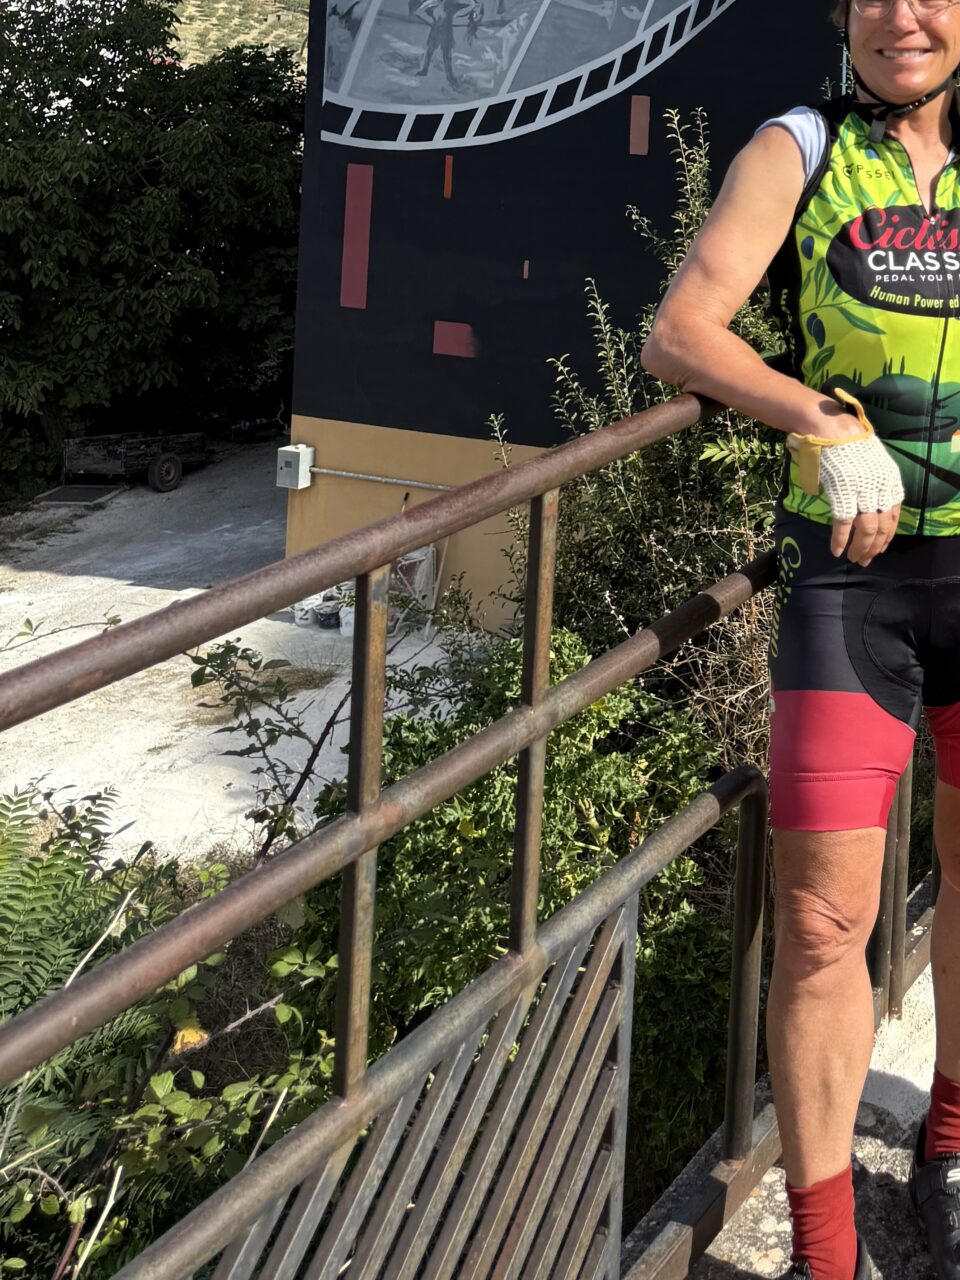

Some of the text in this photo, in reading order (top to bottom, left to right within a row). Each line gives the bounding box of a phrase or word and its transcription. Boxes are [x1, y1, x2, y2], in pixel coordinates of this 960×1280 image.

[875, 273, 915, 283] PEDAL
[919, 273, 954, 283] YOUR
[869, 284, 910, 306] Human
